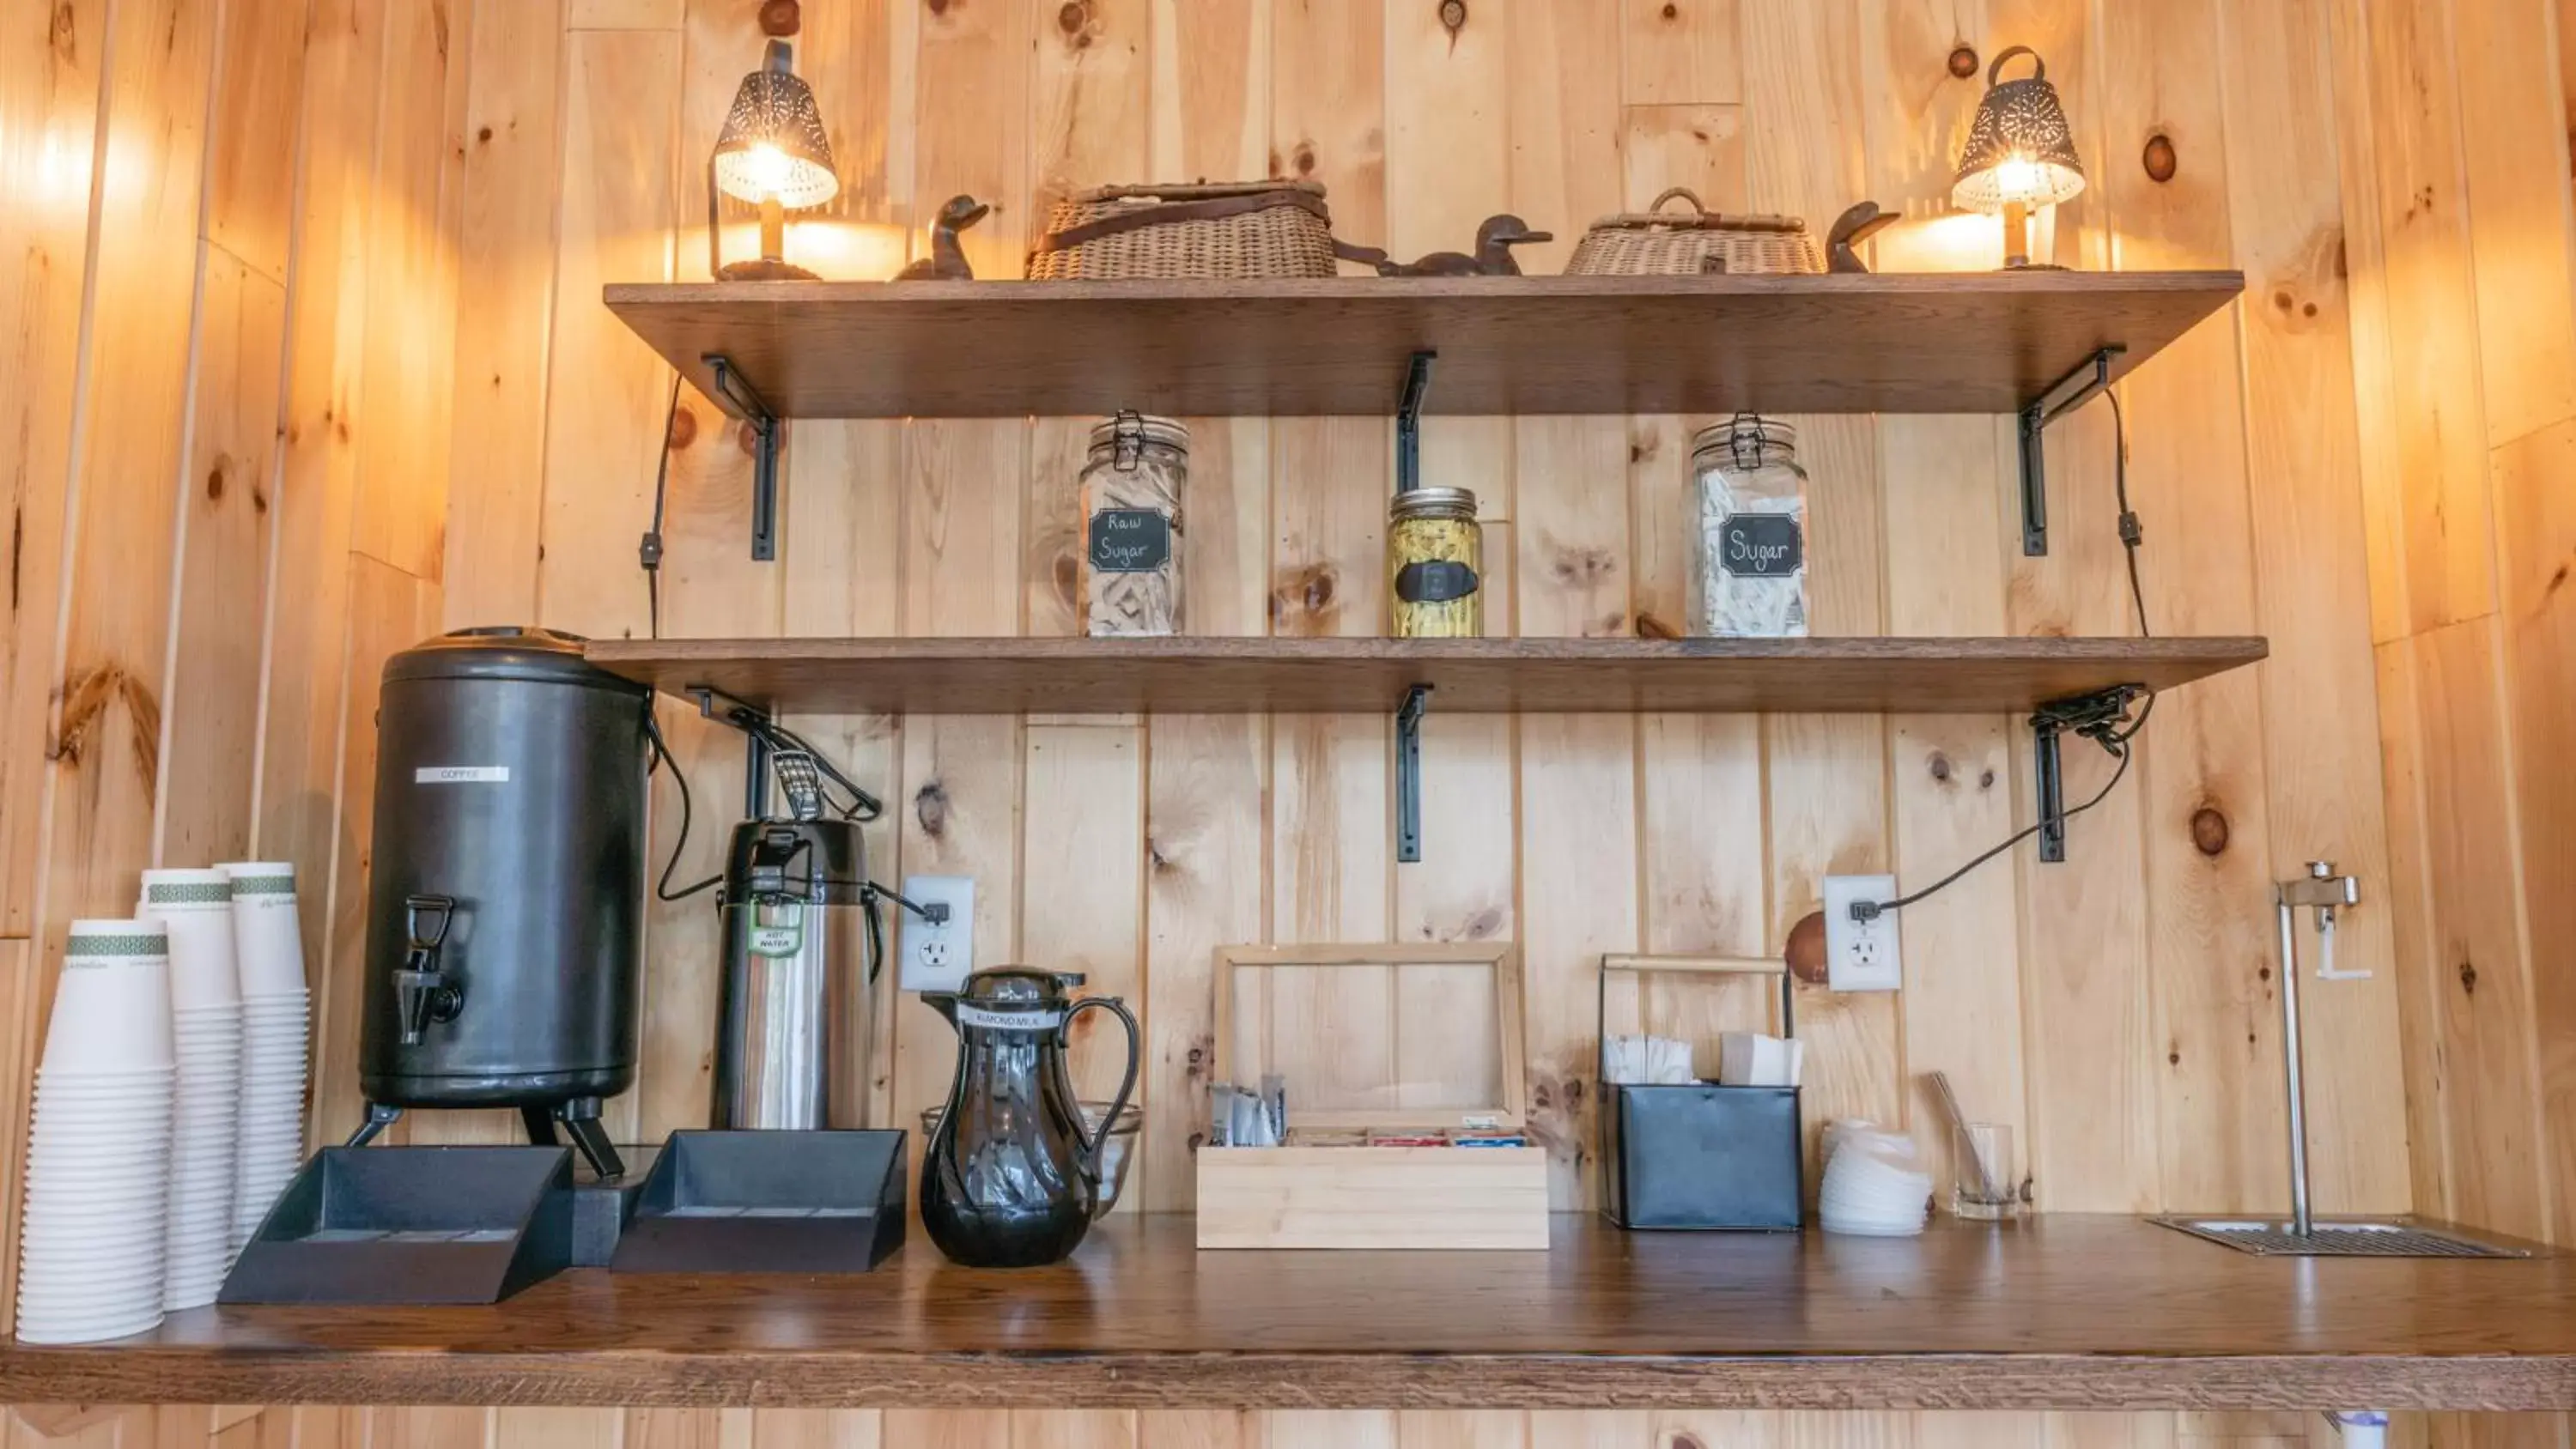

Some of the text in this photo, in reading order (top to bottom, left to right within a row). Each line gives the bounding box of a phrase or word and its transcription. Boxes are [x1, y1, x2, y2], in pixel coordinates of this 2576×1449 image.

[1108, 513, 1141, 530] Raw
[1098, 537, 1149, 567] Sugar
[1730, 529, 1789, 573] Sugar
